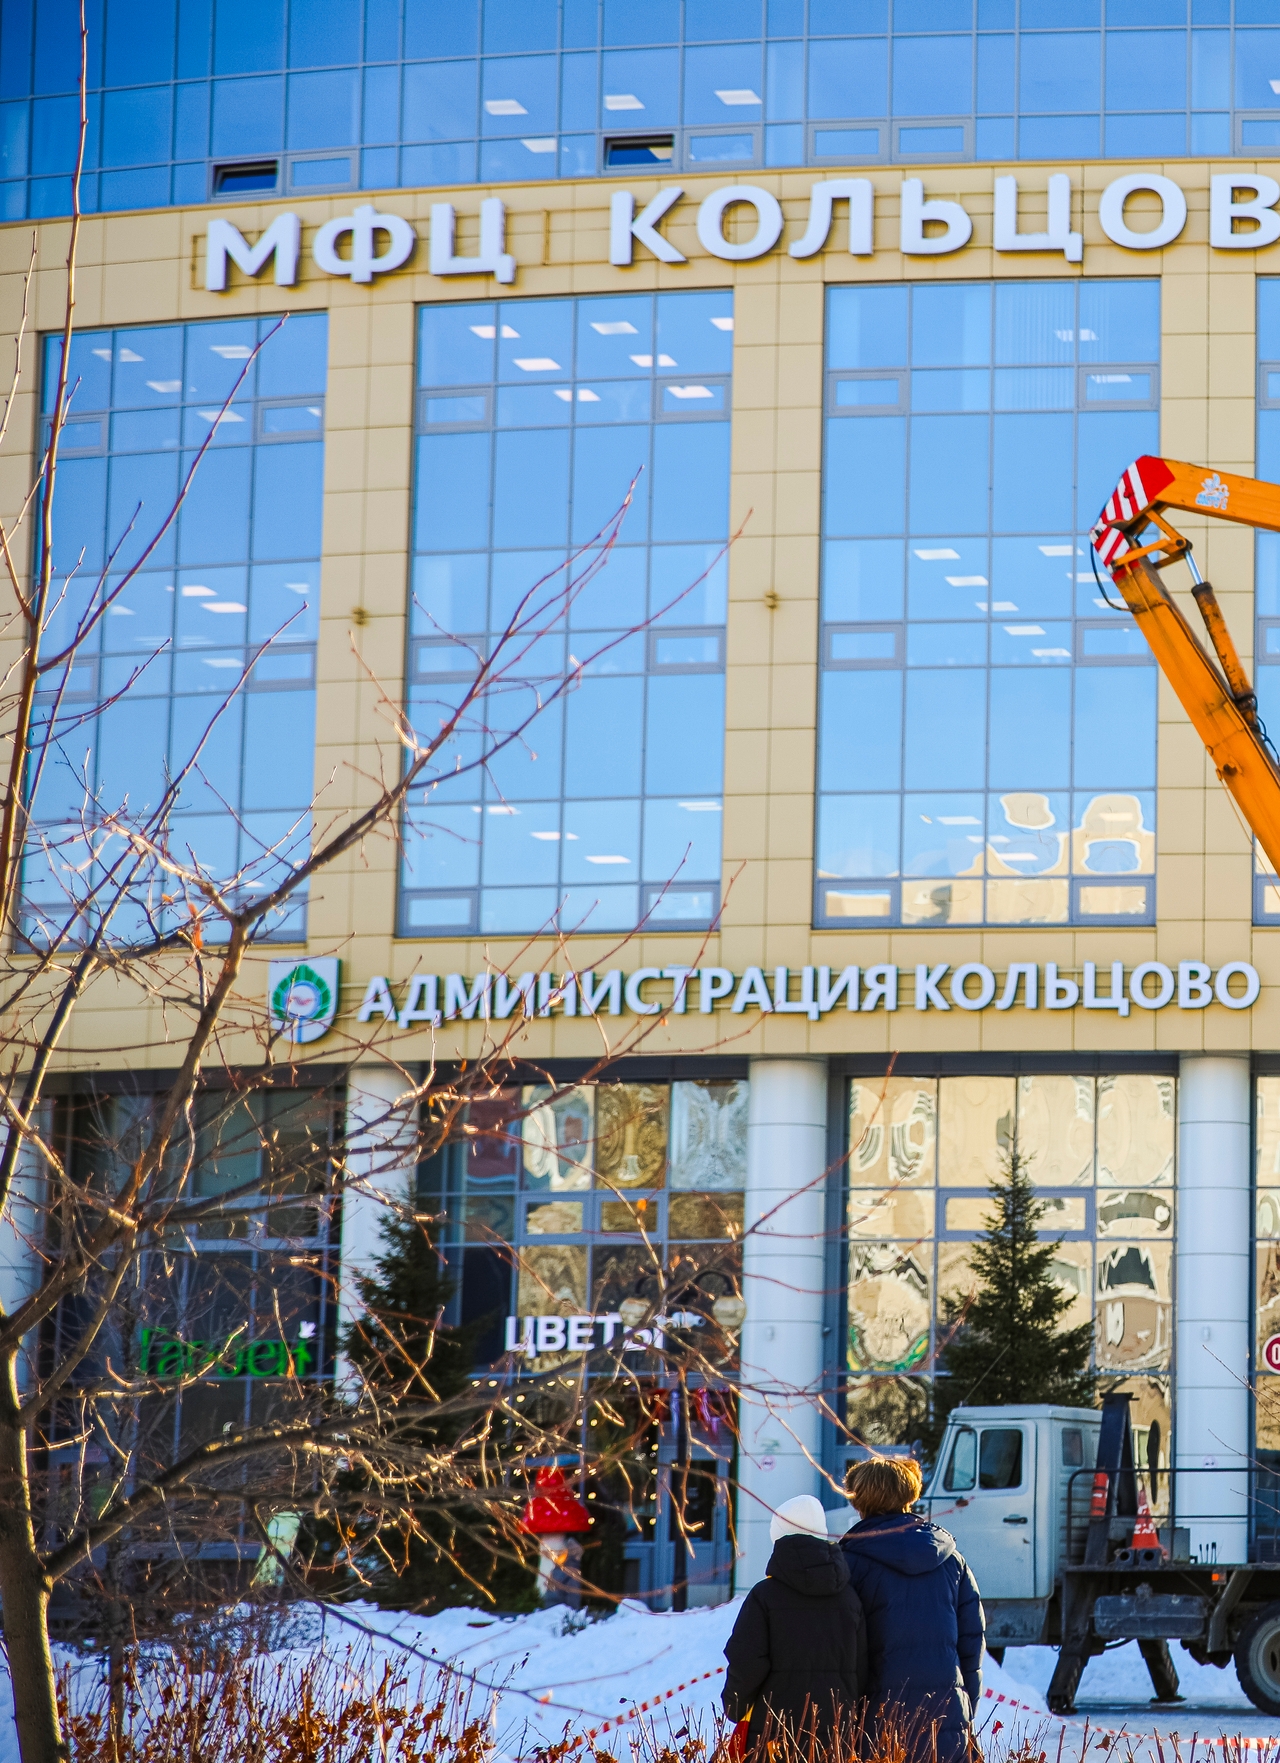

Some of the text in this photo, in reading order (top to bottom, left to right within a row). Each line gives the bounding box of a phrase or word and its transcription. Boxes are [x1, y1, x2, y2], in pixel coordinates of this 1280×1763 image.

[205, 197, 516, 292] МФЦ
[356, 960, 1261, 1028] АДМИНИСТРАЦИЯ КОЛЬЦОВО
[505, 1312, 664, 1358] ЦВЕТЫ
